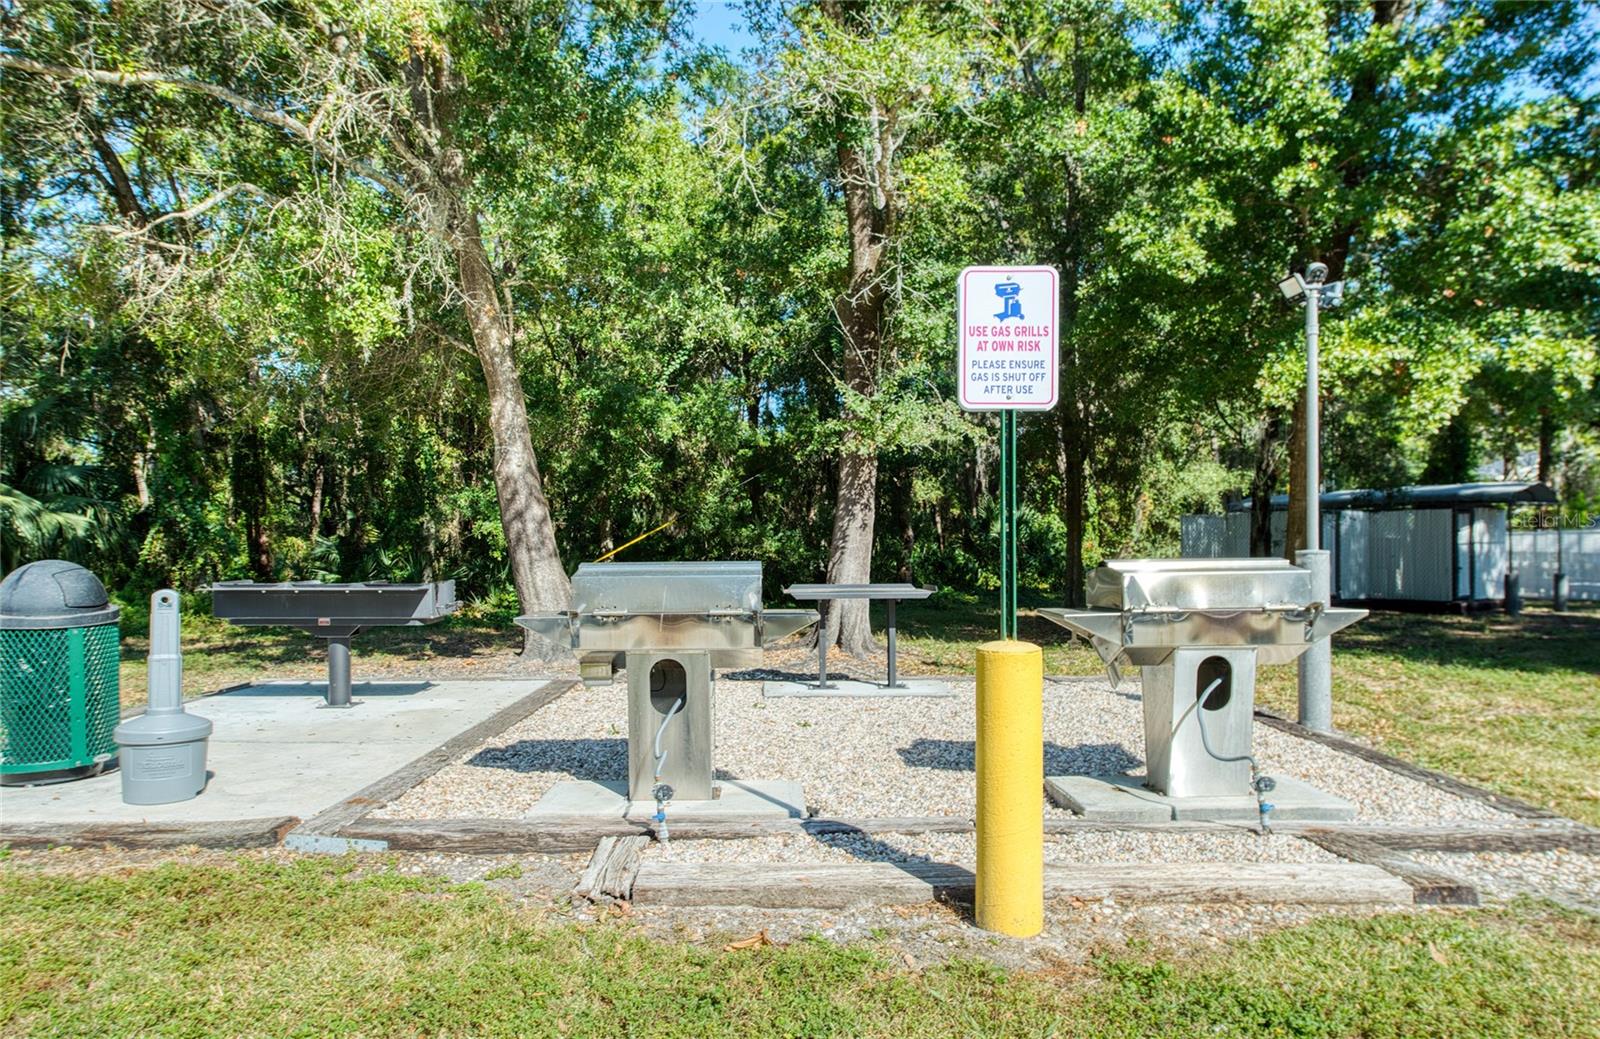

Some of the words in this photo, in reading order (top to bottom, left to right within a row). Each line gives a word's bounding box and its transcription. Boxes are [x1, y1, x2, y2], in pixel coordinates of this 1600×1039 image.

[968, 326, 988, 337] USE
[991, 326, 1011, 337] GAS
[1014, 326, 1049, 337] GRILLS
[976, 340, 988, 351] AT
[991, 340, 1014, 351] OWN
[1017, 340, 1041, 351] RISK
[971, 360, 1006, 369] PLEASE
[1009, 360, 1045, 369] ENSURE
[970, 372, 989, 381] GAS
[991, 372, 1000, 381] IS
[1002, 372, 1026, 381] SHUT
[1029, 372, 1046, 381] OFF
[983, 385, 1013, 394] AFTER
[1015, 385, 1034, 394] USE
